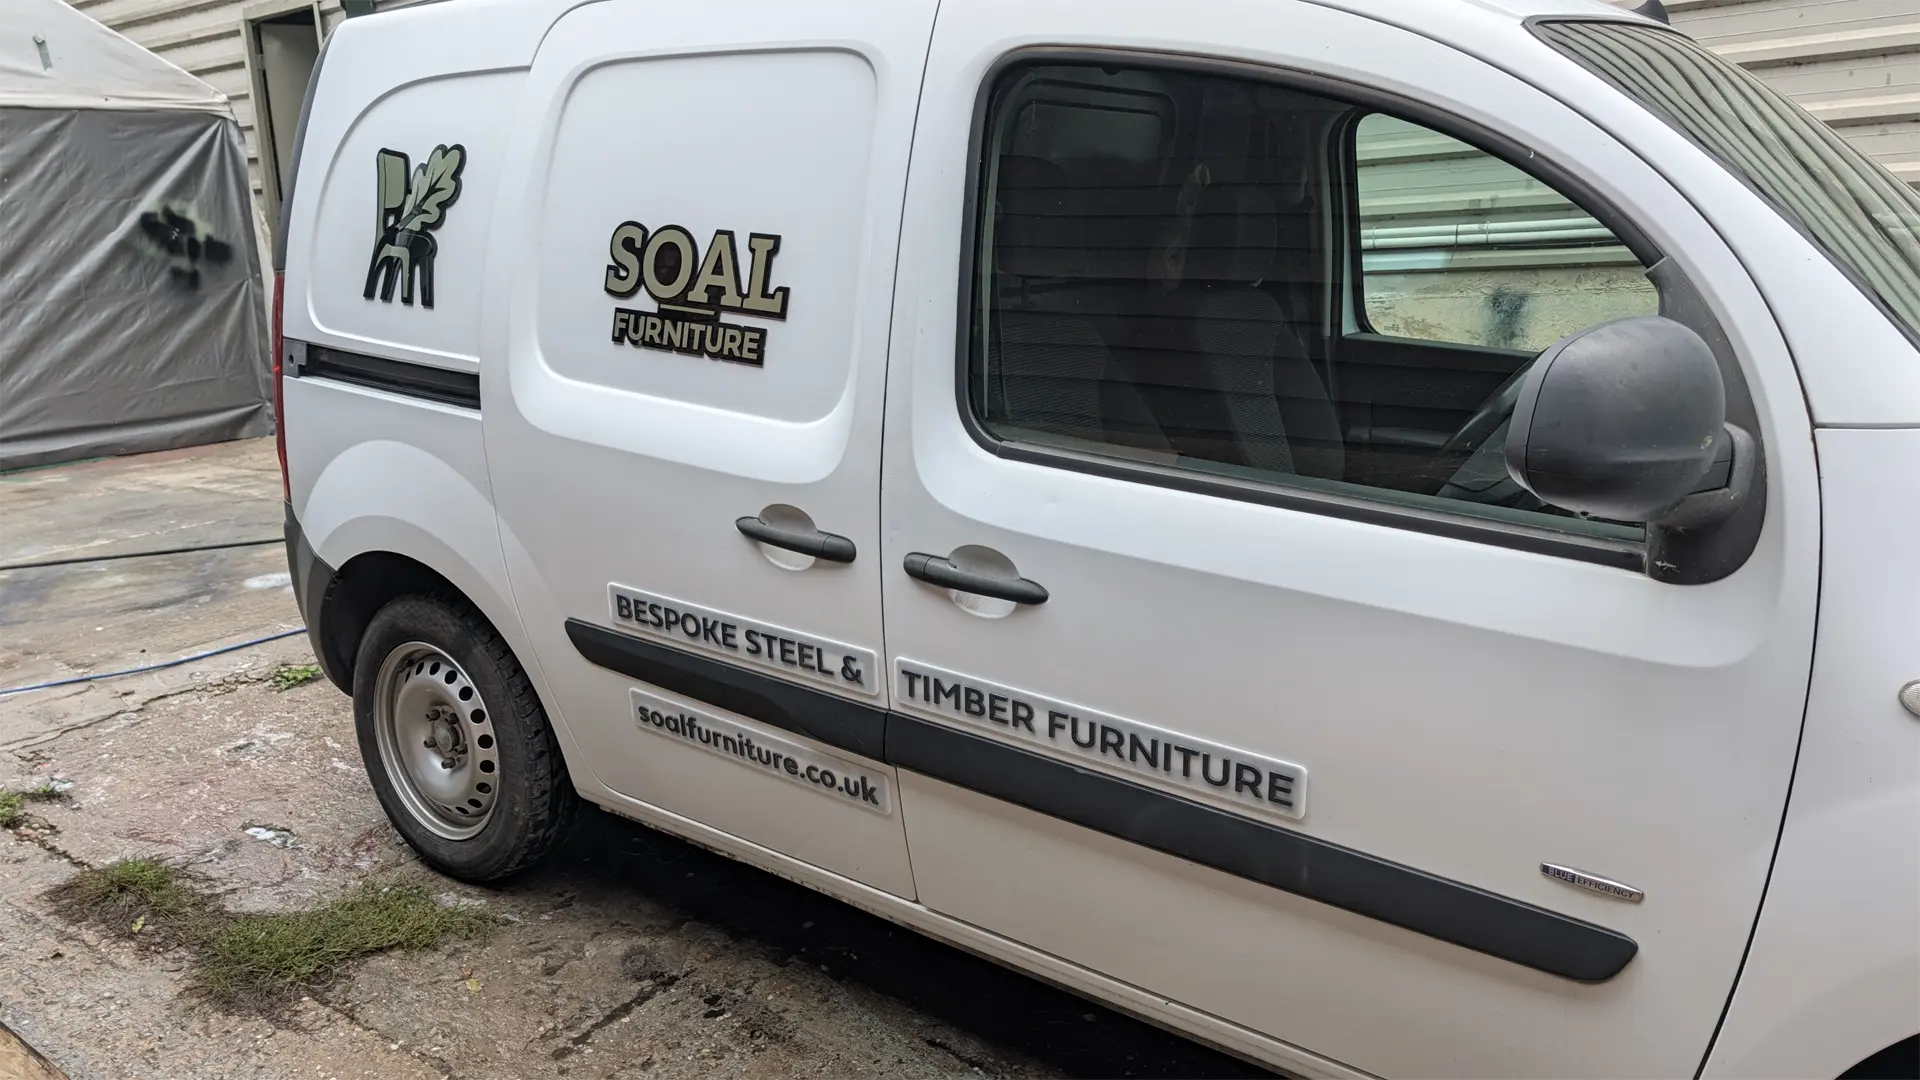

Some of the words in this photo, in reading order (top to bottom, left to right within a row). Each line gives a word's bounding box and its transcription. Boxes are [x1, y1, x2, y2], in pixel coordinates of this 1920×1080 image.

[605, 222, 788, 318] SOAL
[613, 310, 764, 363] FURNITURE
[616, 594, 739, 649] BESPOKE
[744, 628, 834, 677] STEEL
[840, 654, 864, 685] &
[637, 703, 880, 806] soalfurniture.co.uk
[901, 669, 1036, 733] TIMBER
[1047, 710, 1295, 807] FURNITURE
[1547, 867, 1573, 882] BLUE
[1577, 877, 1635, 899] EFFICIENCY
